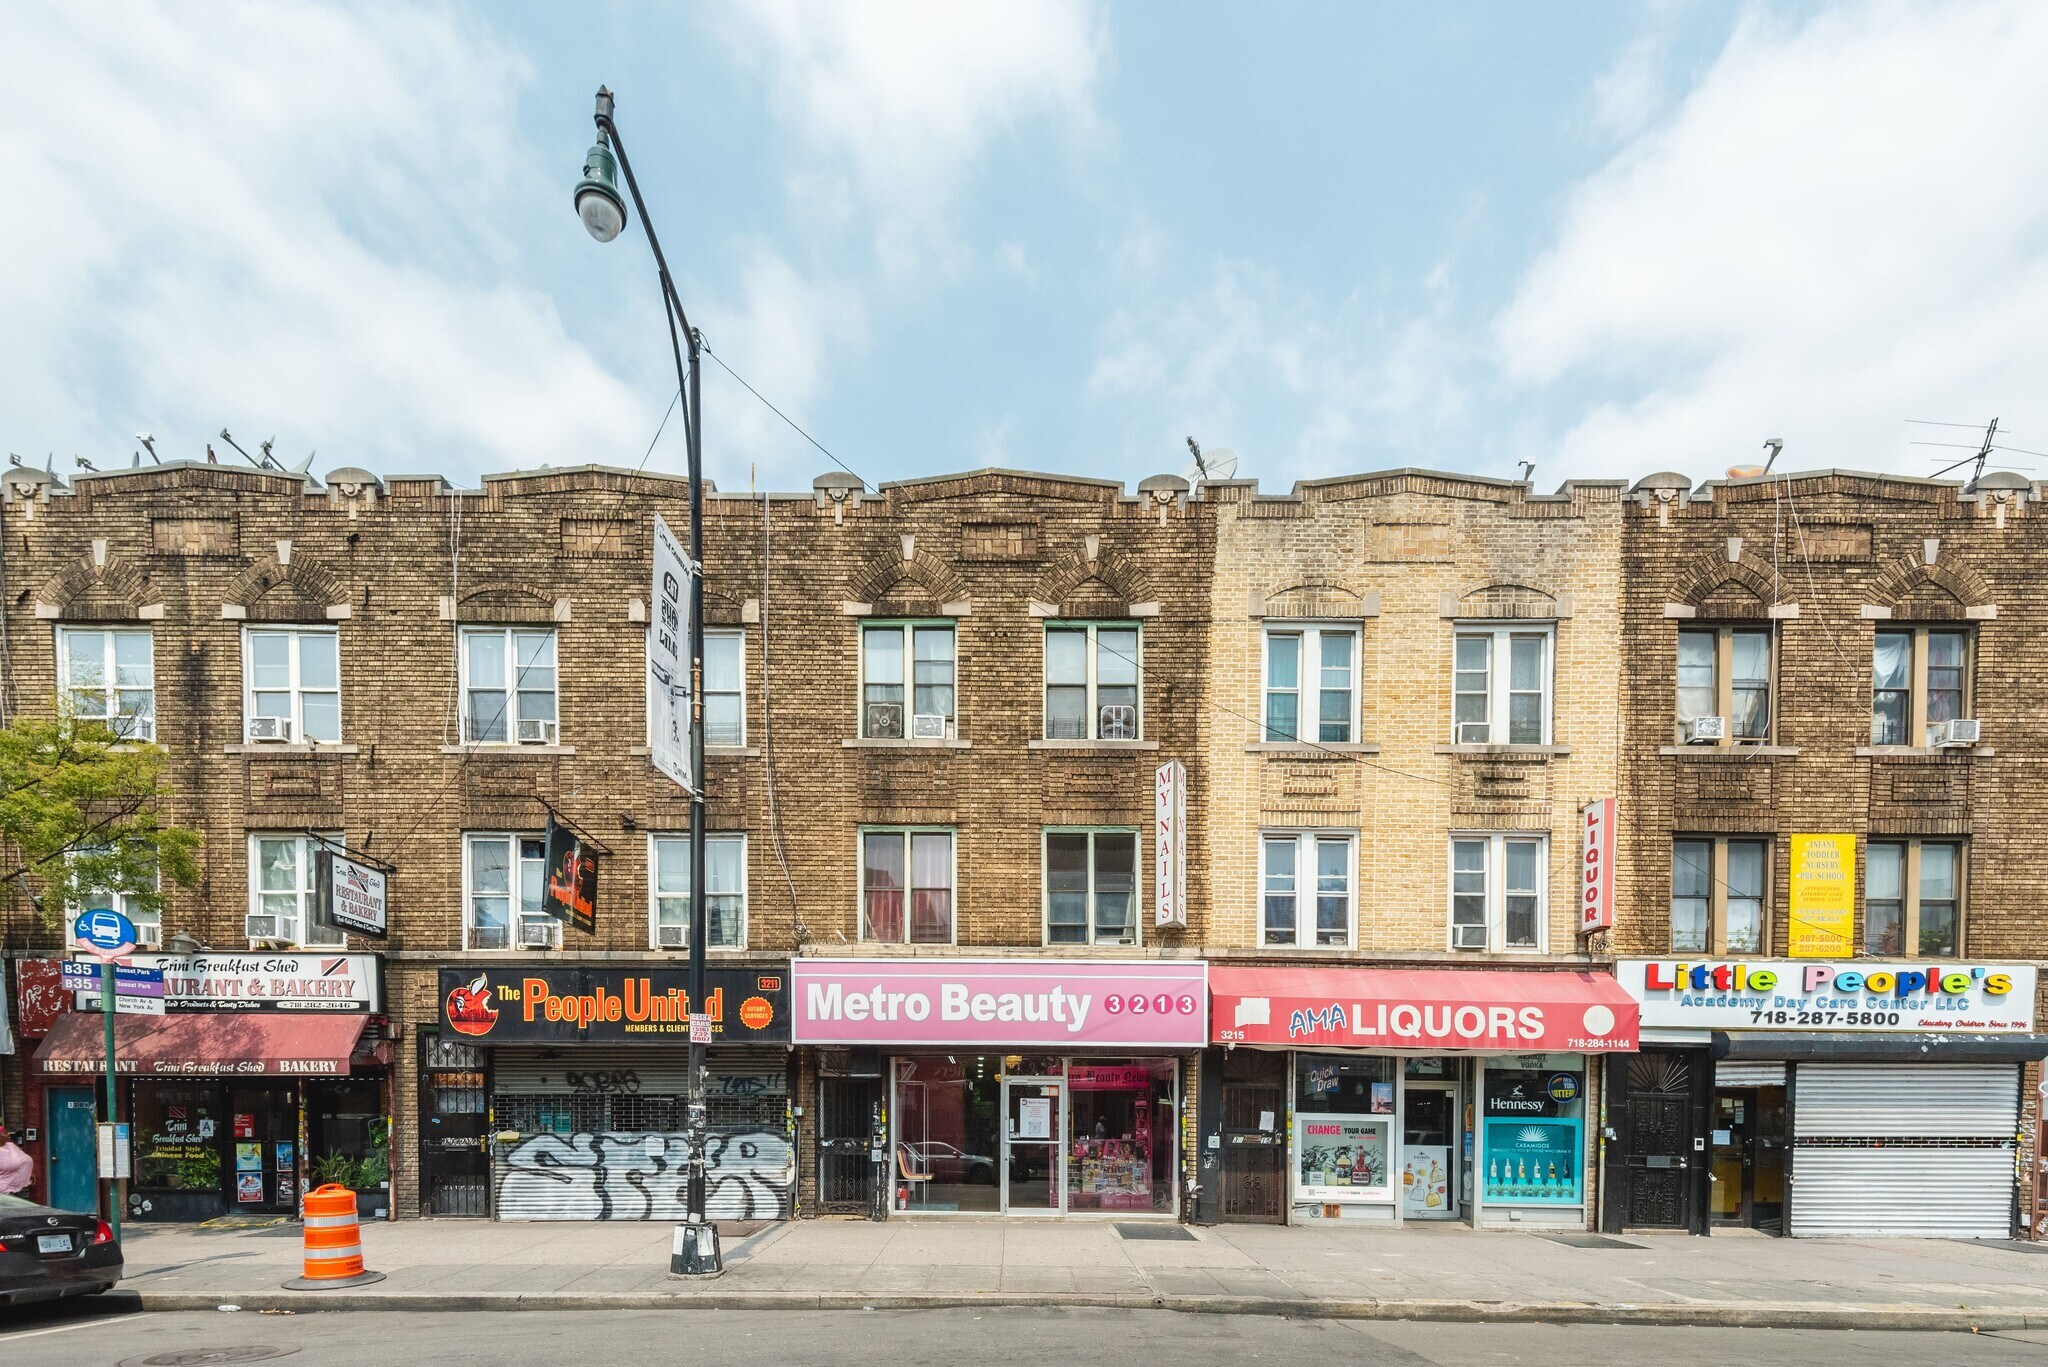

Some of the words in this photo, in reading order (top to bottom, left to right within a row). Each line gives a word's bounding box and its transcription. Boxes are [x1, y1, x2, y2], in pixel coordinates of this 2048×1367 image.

[1158, 767, 1172, 807] MY
[1159, 817, 1171, 919] NAILS
[1585, 812, 1599, 923] LIQUOR
[335, 884, 382, 910] RESTAURANT
[341, 900, 348, 913] &
[349, 902, 378, 921] BAKERY
[64, 963, 92, 975] B35
[116, 966, 136, 975] Sunset
[156, 958, 189, 972] Trini
[193, 958, 260, 975] Breakfast
[263, 957, 298, 972] Shed
[65, 978, 92, 990] B35
[761, 979, 778, 989] 3211
[1645, 963, 1778, 991] Little
[1802, 966, 2013, 998] People's
[163, 978, 242, 996] AURANT
[247, 978, 265, 997] &
[270, 979, 356, 998] BAKERY
[497, 985, 521, 1001] The
[523, 978, 622, 1029] People
[624, 978, 723, 1022] Unitd
[806, 982, 931, 1022] Metro
[940, 983, 1092, 1033] Beauty
[1107, 995, 1195, 1015] 3213
[1681, 994, 1763, 1011] Academy
[1774, 996, 1808, 1011] Day
[1816, 996, 1858, 1010] Care
[1866, 997, 1928, 1010] Center
[1935, 998, 1970, 1011] LLC
[1289, 1003, 1347, 1039] AMA
[1352, 1004, 1545, 1040] LIQUORS
[1750, 1011, 1900, 1026] 718-287-5800
[1918, 1019, 1953, 1028] Educating
[1956, 1019, 1985, 1027] Children
[1989, 1020, 2008, 1028] Since
[2011, 1021, 2027, 1029] 1996
[625, 1024, 658, 1033] MEMBERS
[659, 1025, 666, 1033] &
[1221, 1031, 1245, 1040] 3215
[1567, 1038, 1630, 1048] 718-284-1144
[153, 1061, 180, 1072] Trini
[183, 1061, 234, 1074] Breakfast
[236, 1061, 265, 1072] Shed
[279, 1060, 338, 1072] BAKERY
[1085, 1070, 1120, 1083] Beauty
[1122, 1070, 1150, 1084] News
[1310, 1065, 1334, 1082] Quick
[1317, 1077, 1339, 1092] Draw
[1551, 1089, 1576, 1098] LOTTERY
[1490, 1097, 1545, 1112] Hennessy
[165, 1119, 187, 1132] Trini
[202, 1121, 211, 1132] A
[1307, 1124, 1341, 1135] CHANGE
[1344, 1127, 1360, 1135] YOUR
[1360, 1127, 1376, 1135] GAME
[152, 1133, 184, 1145] Breakfast
[185, 1133, 203, 1143] Shed
